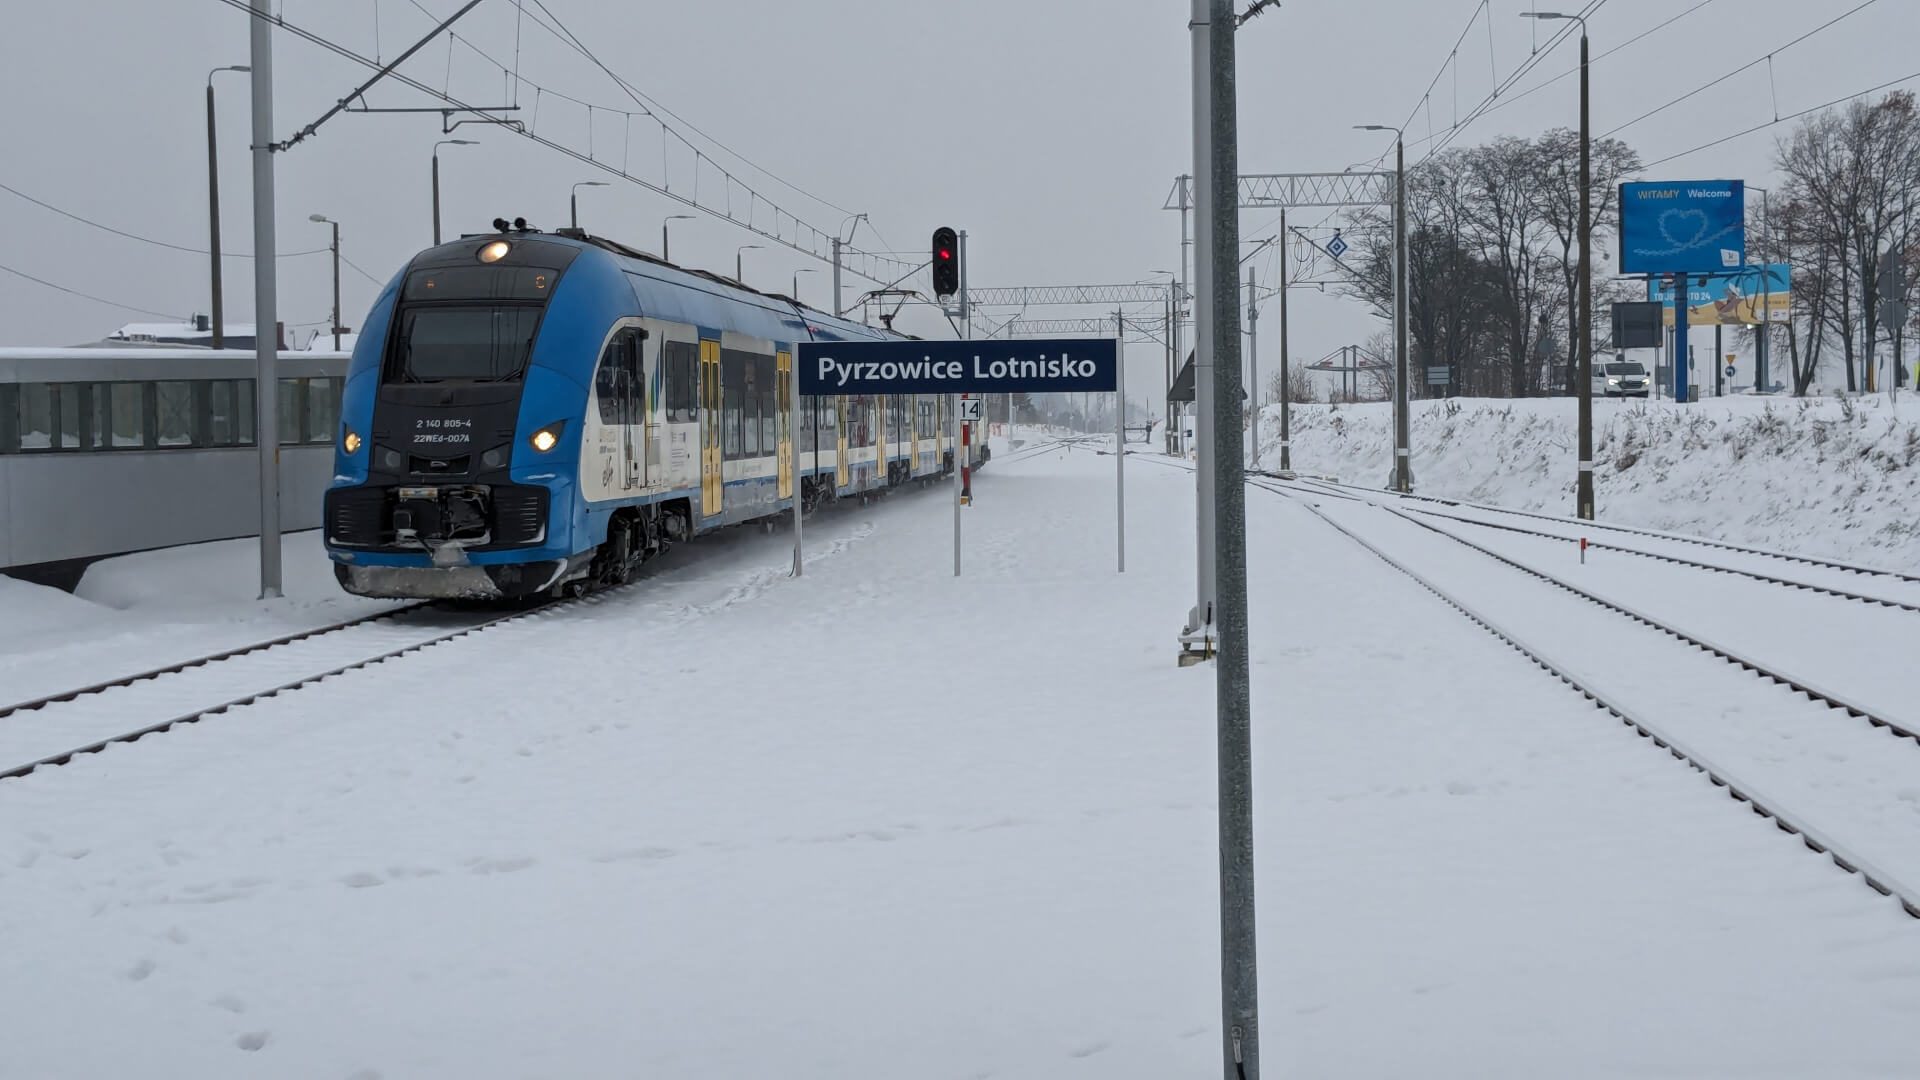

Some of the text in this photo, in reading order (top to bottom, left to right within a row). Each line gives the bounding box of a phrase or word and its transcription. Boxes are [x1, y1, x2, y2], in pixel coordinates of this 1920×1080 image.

[1638, 188, 1732, 200] WITAMY Welcome
[1701, 291, 1711, 301] 24
[817, 353, 1097, 387] Pyrzowice Lotnisko
[961, 401, 979, 418] 14
[416, 419, 472, 428] 2 140 805-4
